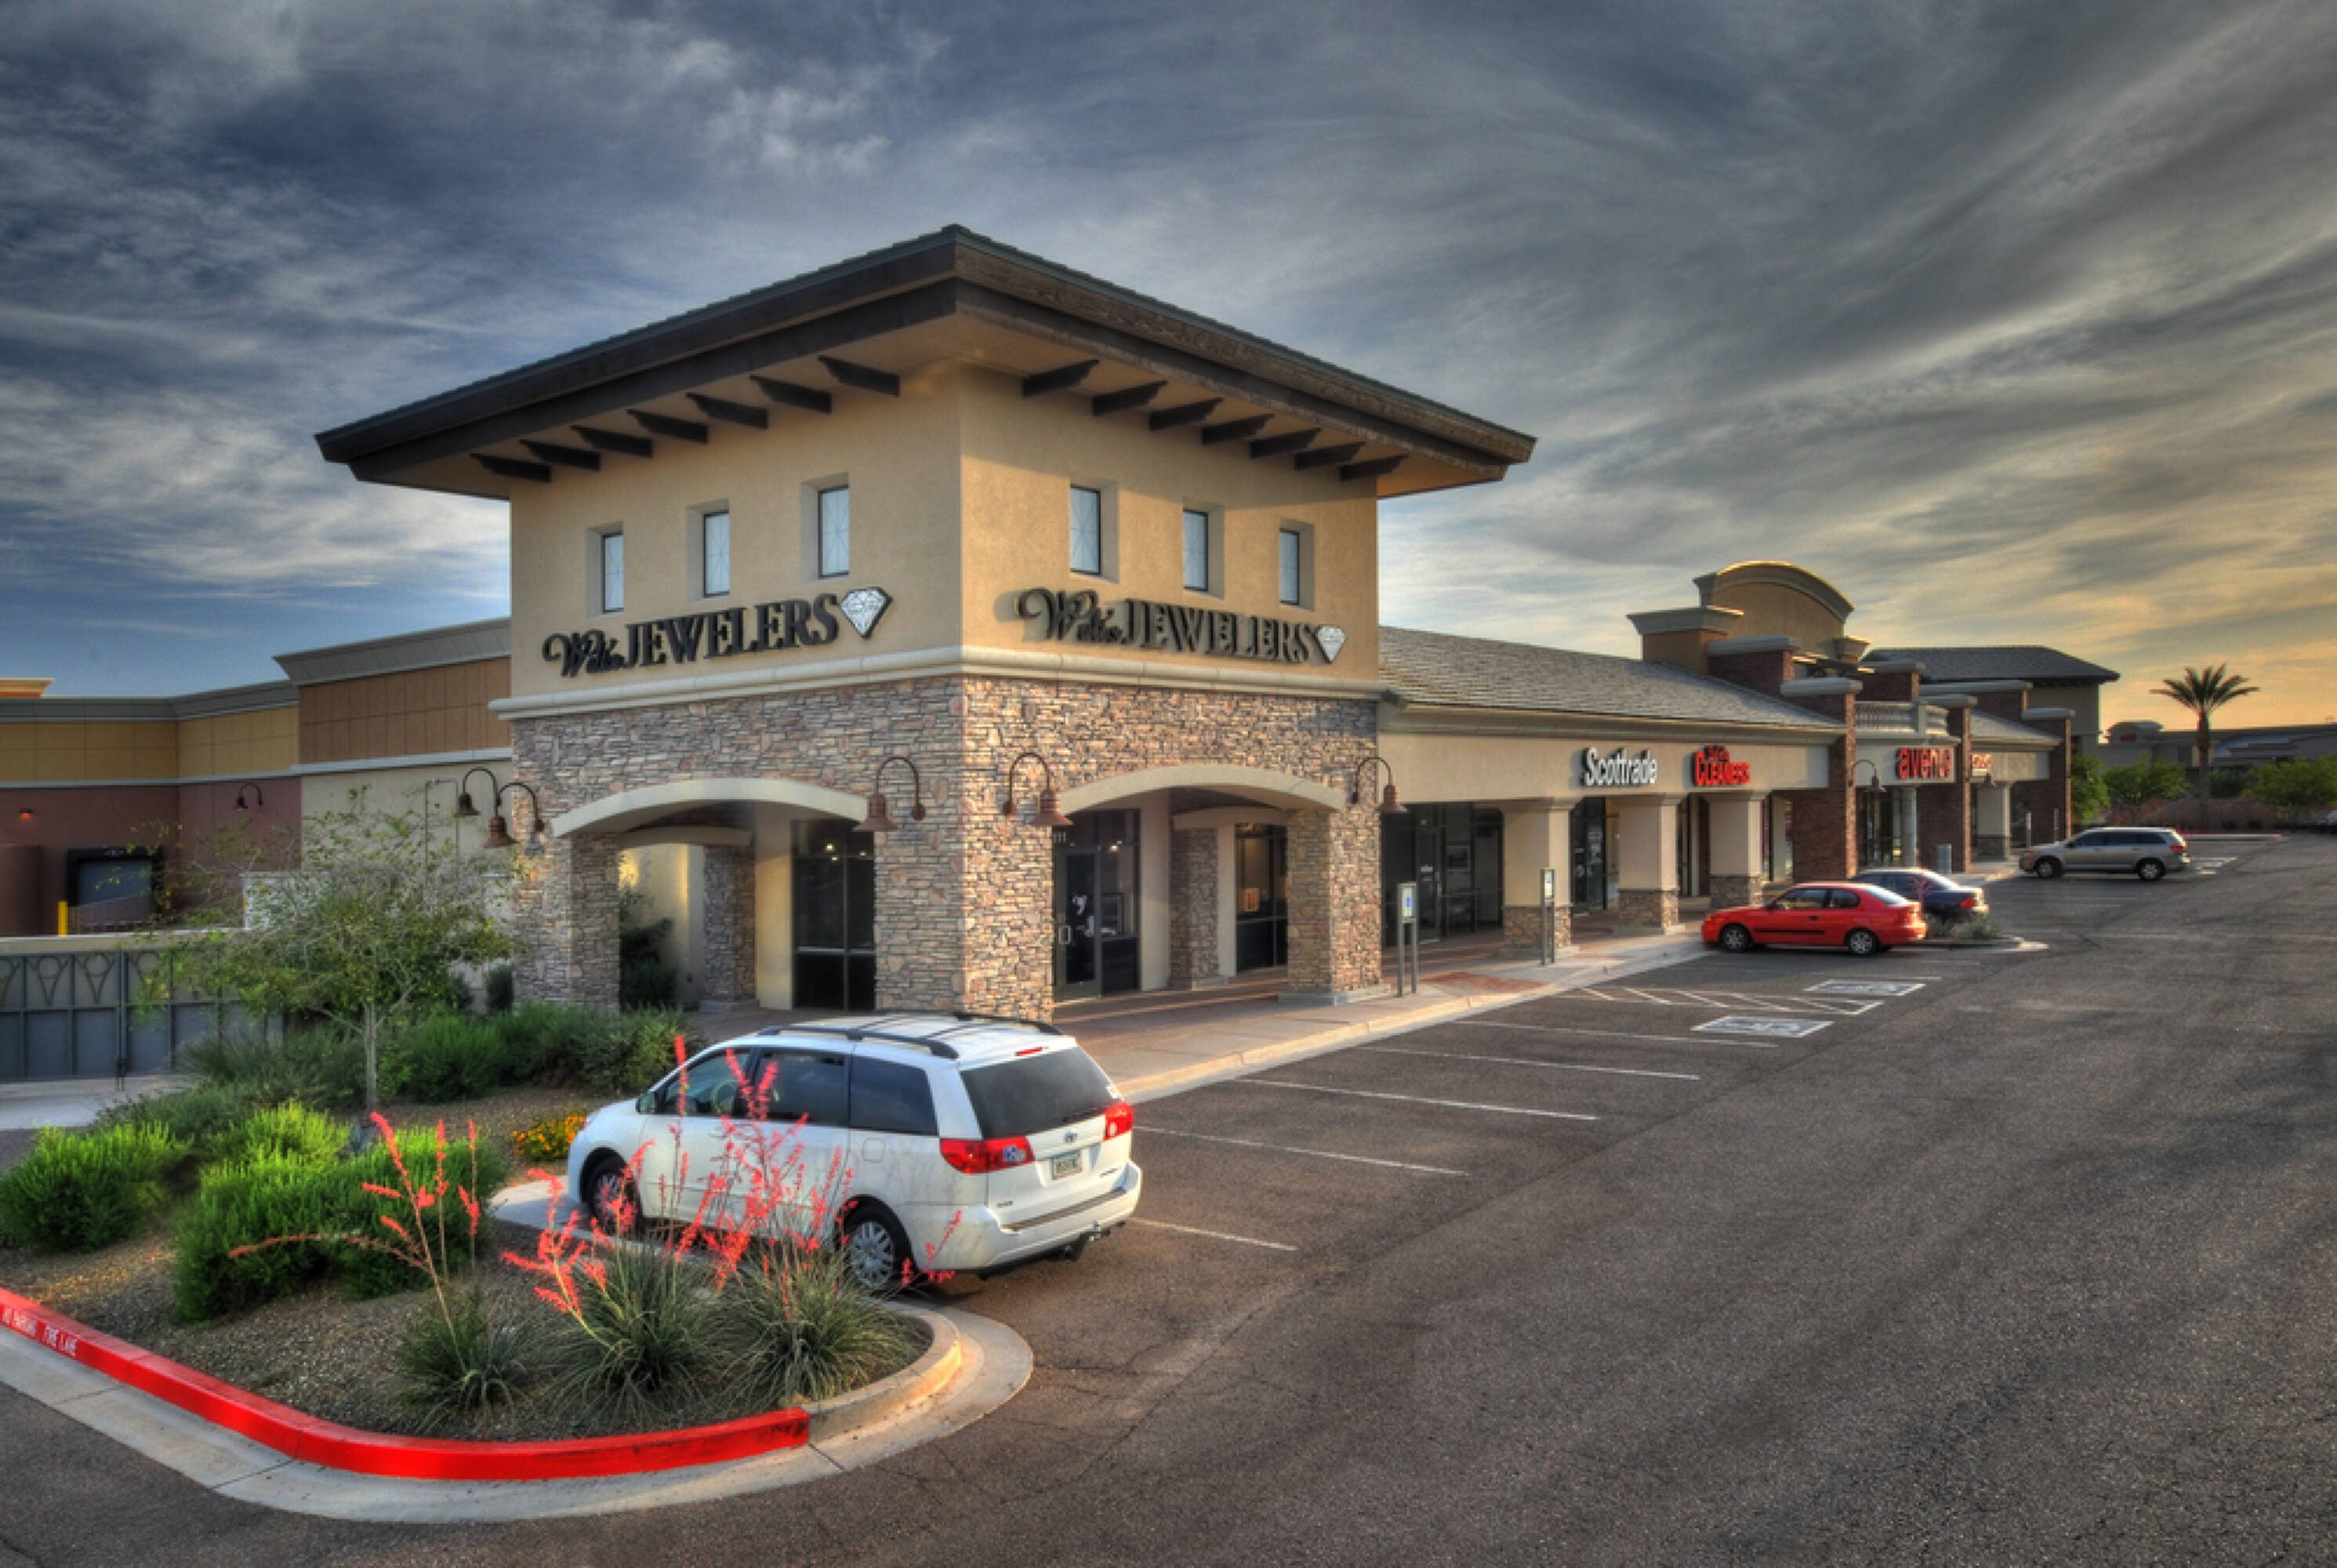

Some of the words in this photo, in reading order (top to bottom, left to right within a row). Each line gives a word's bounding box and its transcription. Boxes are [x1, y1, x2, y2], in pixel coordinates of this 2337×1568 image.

[626, 593, 838, 669] JEWELERS
[1124, 597, 1322, 663] JEWELERS
[1585, 746, 1657, 786] Scottrade
